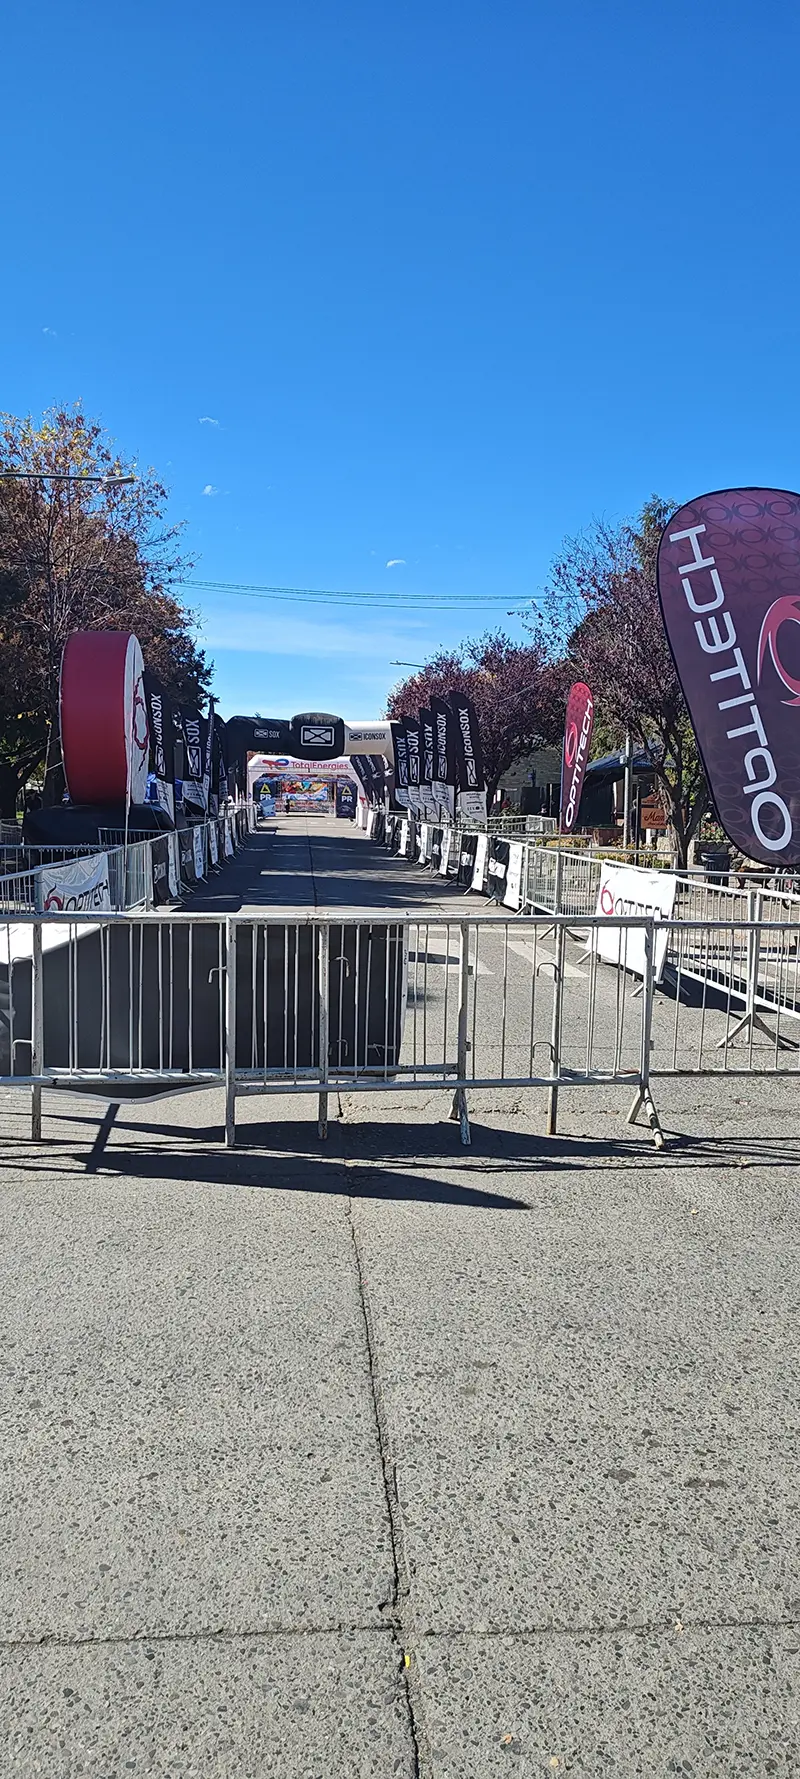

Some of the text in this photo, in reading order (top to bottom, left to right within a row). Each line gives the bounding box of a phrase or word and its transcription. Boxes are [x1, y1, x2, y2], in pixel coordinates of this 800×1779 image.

[185, 719, 199, 744] SOX
[268, 730, 281, 739] SOX
[363, 731, 387, 740] ICONSOX
[436, 712, 447, 755] ICONSOX
[458, 708, 474, 757] ICONSOX
[406, 729, 419, 753] SOX
[291, 761, 349, 771] TotalEnergies
[565, 698, 593, 828] OPTITECH
[260, 793, 272, 801] PR
[341, 795, 353, 803] PR
